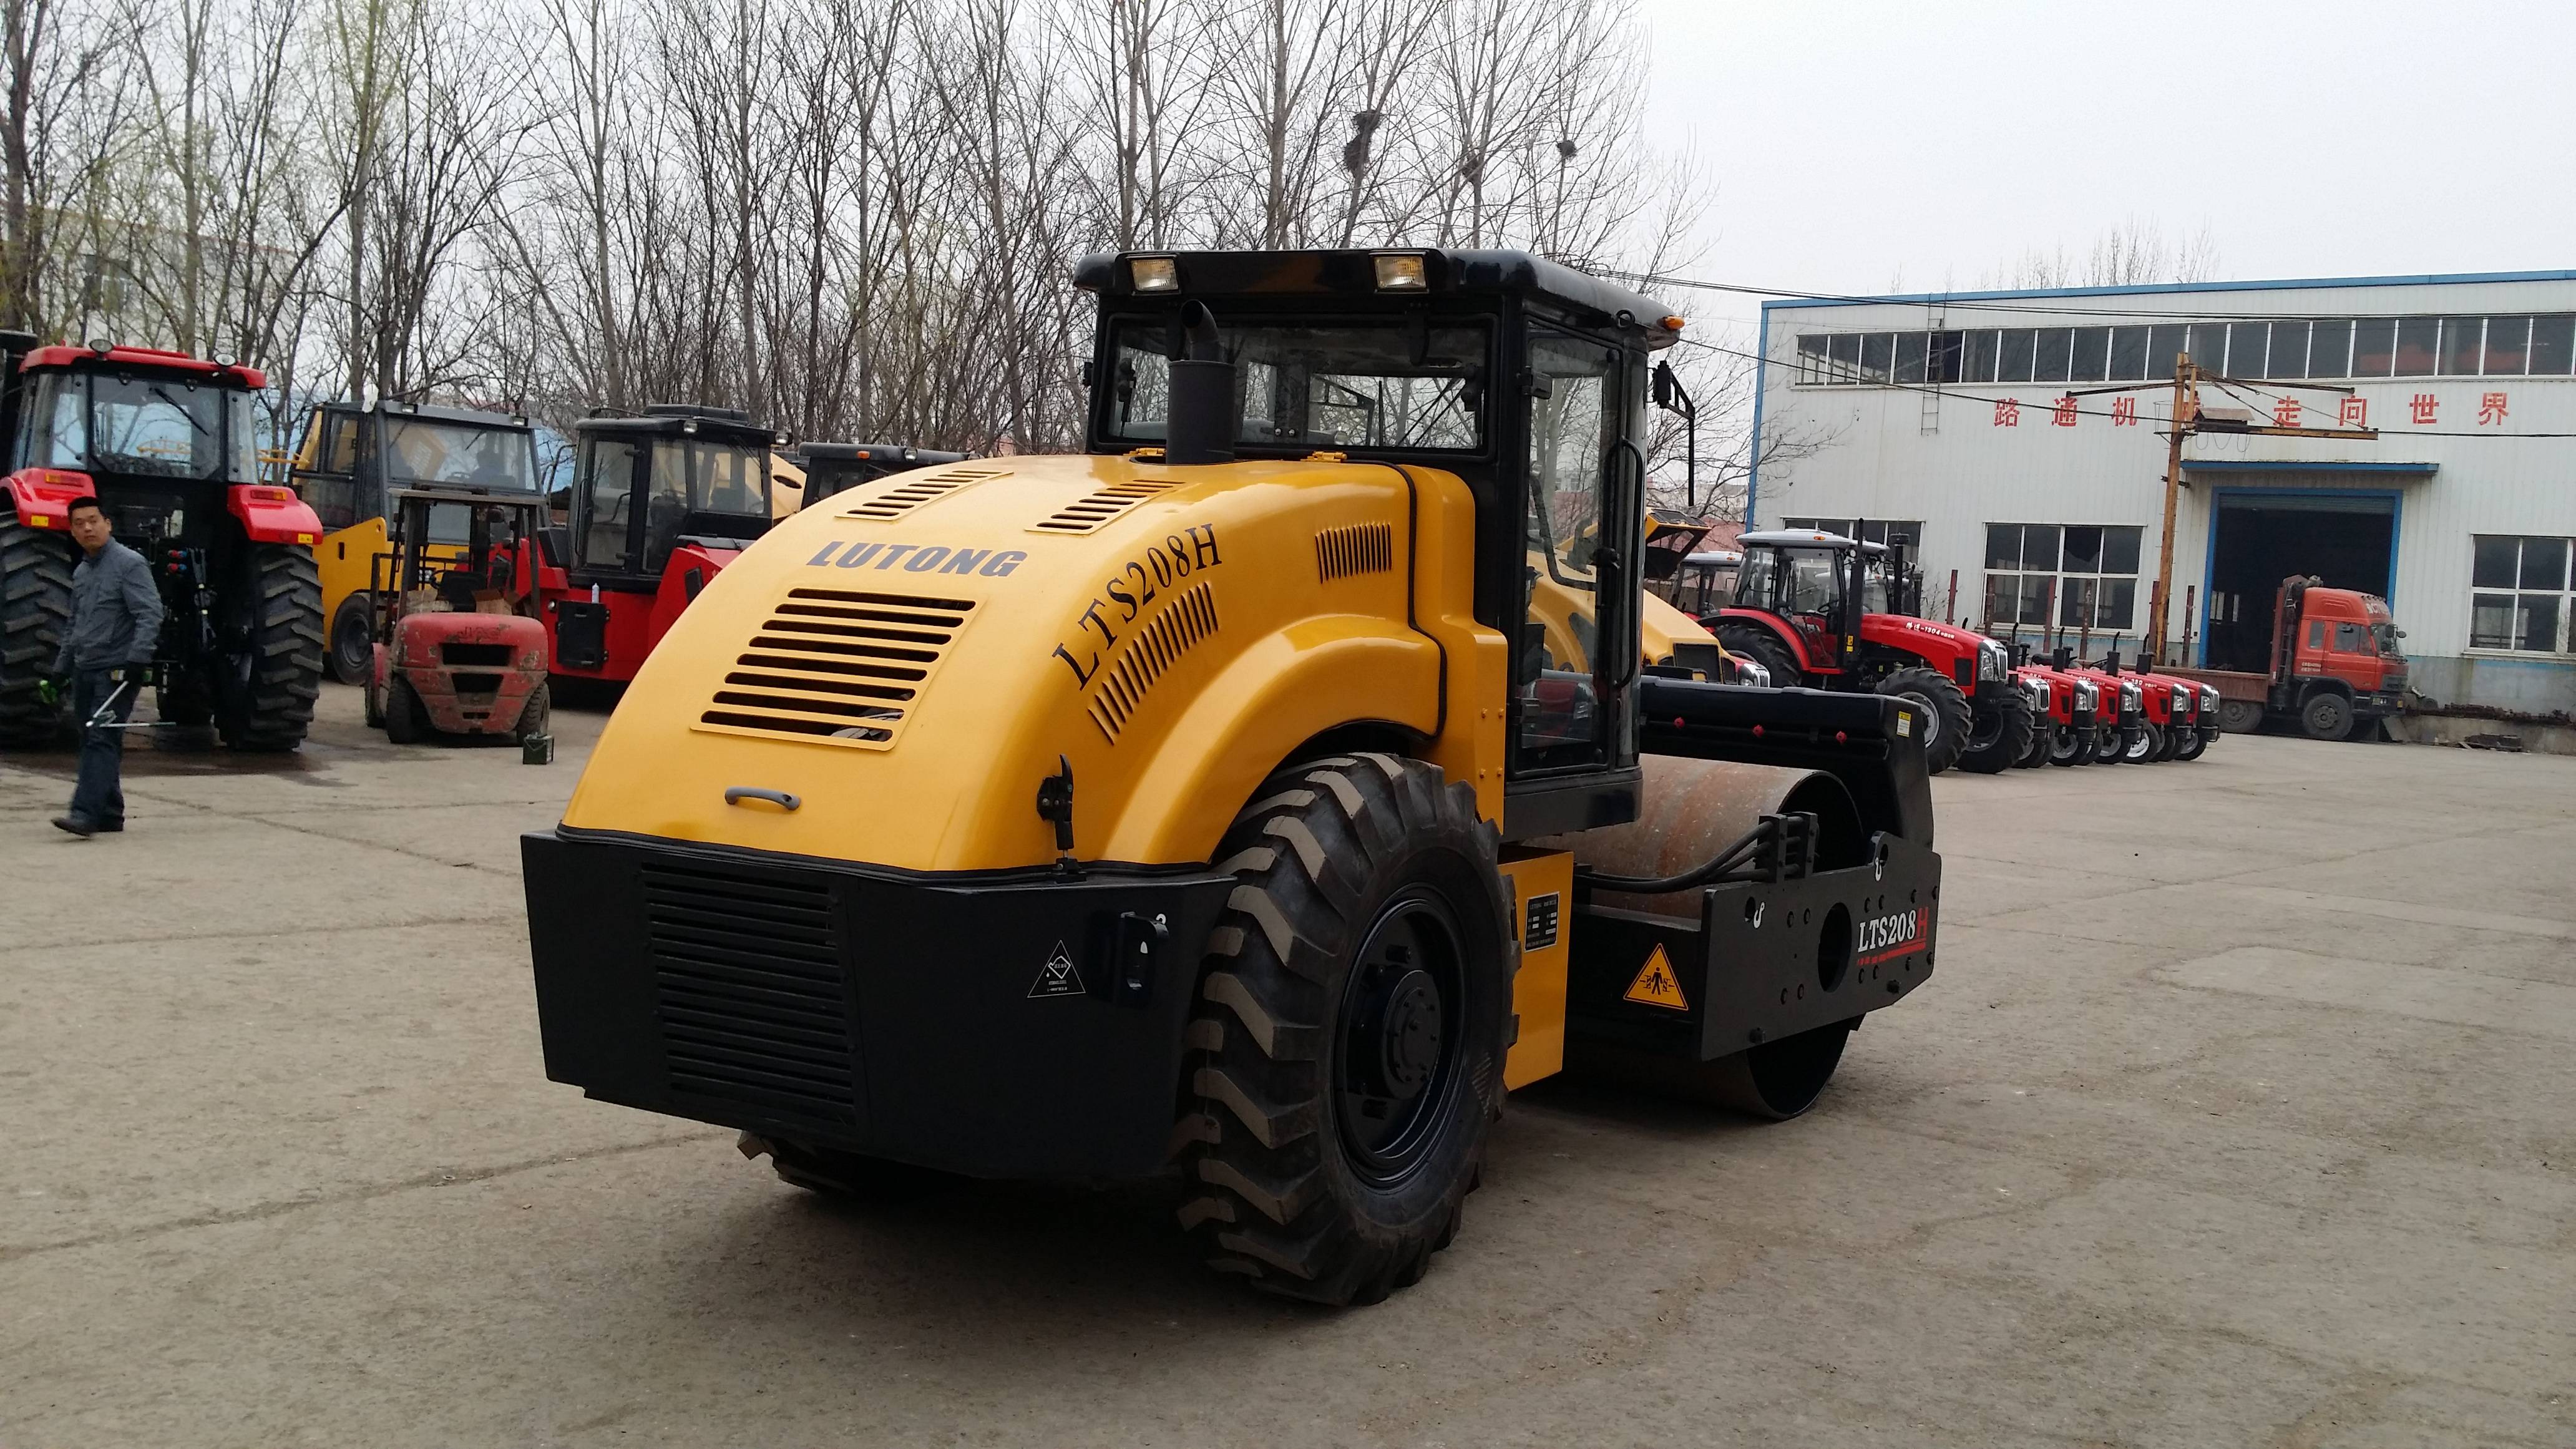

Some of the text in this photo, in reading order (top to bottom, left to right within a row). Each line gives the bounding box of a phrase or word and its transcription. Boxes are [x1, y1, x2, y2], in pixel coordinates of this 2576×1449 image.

[1994, 392, 2509, 427] 路通机 走向世界
[806, 540, 1028, 577] LUTONG
[1051, 523, 1222, 691] LTS208H
[1857, 906, 1929, 953] LTS208H
